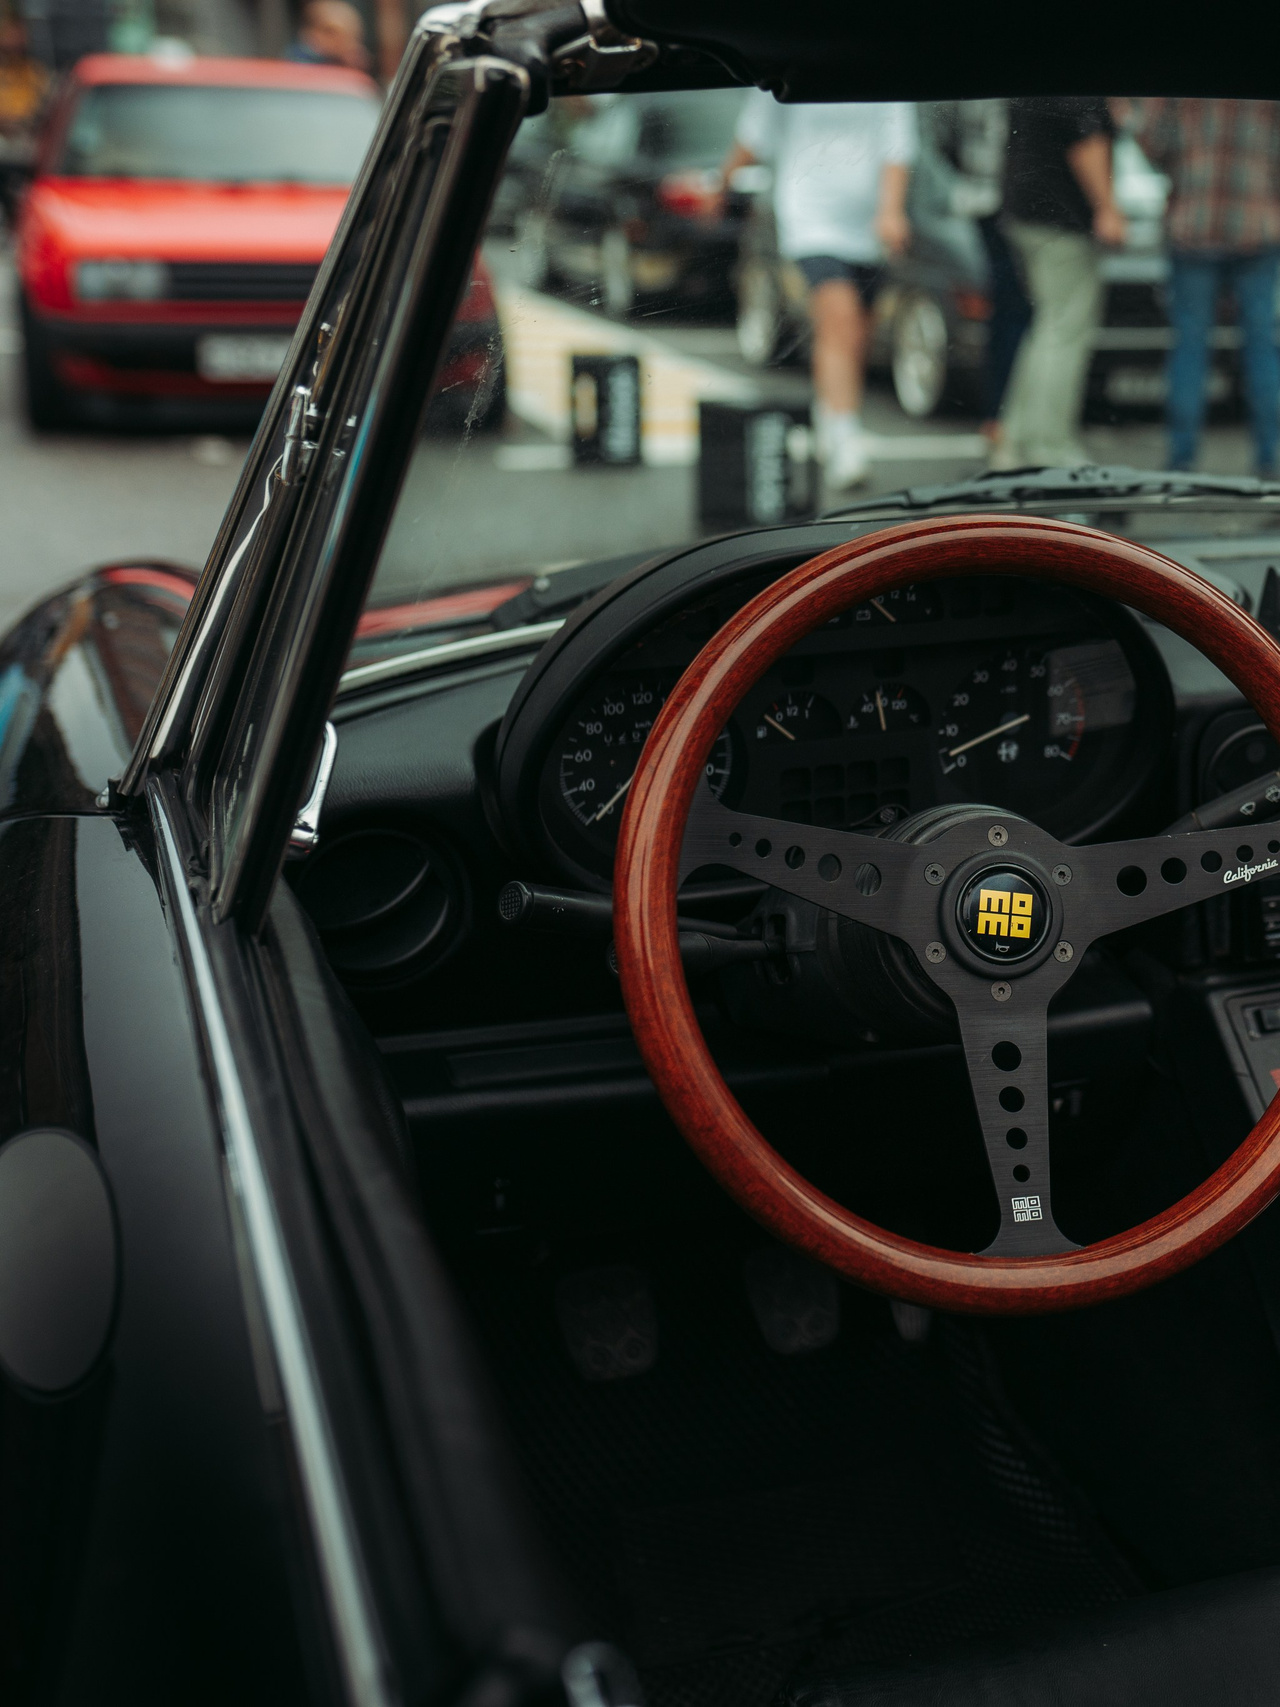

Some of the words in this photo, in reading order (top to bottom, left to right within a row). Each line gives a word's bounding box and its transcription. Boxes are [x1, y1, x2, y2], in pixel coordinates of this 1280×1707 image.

[891, 590, 900, 599] 12
[906, 592, 916, 602] 14
[1001, 659, 1018, 671] 40
[1030, 665, 1046, 678] 50
[972, 670, 990, 683] 30
[1047, 684, 1064, 697] 60
[632, 692, 653, 705] 120
[891, 699, 908, 711] 120
[953, 692, 970, 707] 20
[603, 702, 625, 716] 100
[861, 702, 875, 714] 40
[776, 712, 784, 722] 0
[586, 721, 603, 735] 80
[945, 723, 959, 737] 10
[574, 749, 592, 763] 60
[1044, 744, 1061, 758] 80
[957, 754, 967, 767] 0
[579, 778, 595, 792] 40
[1223, 858, 1279, 884] California
